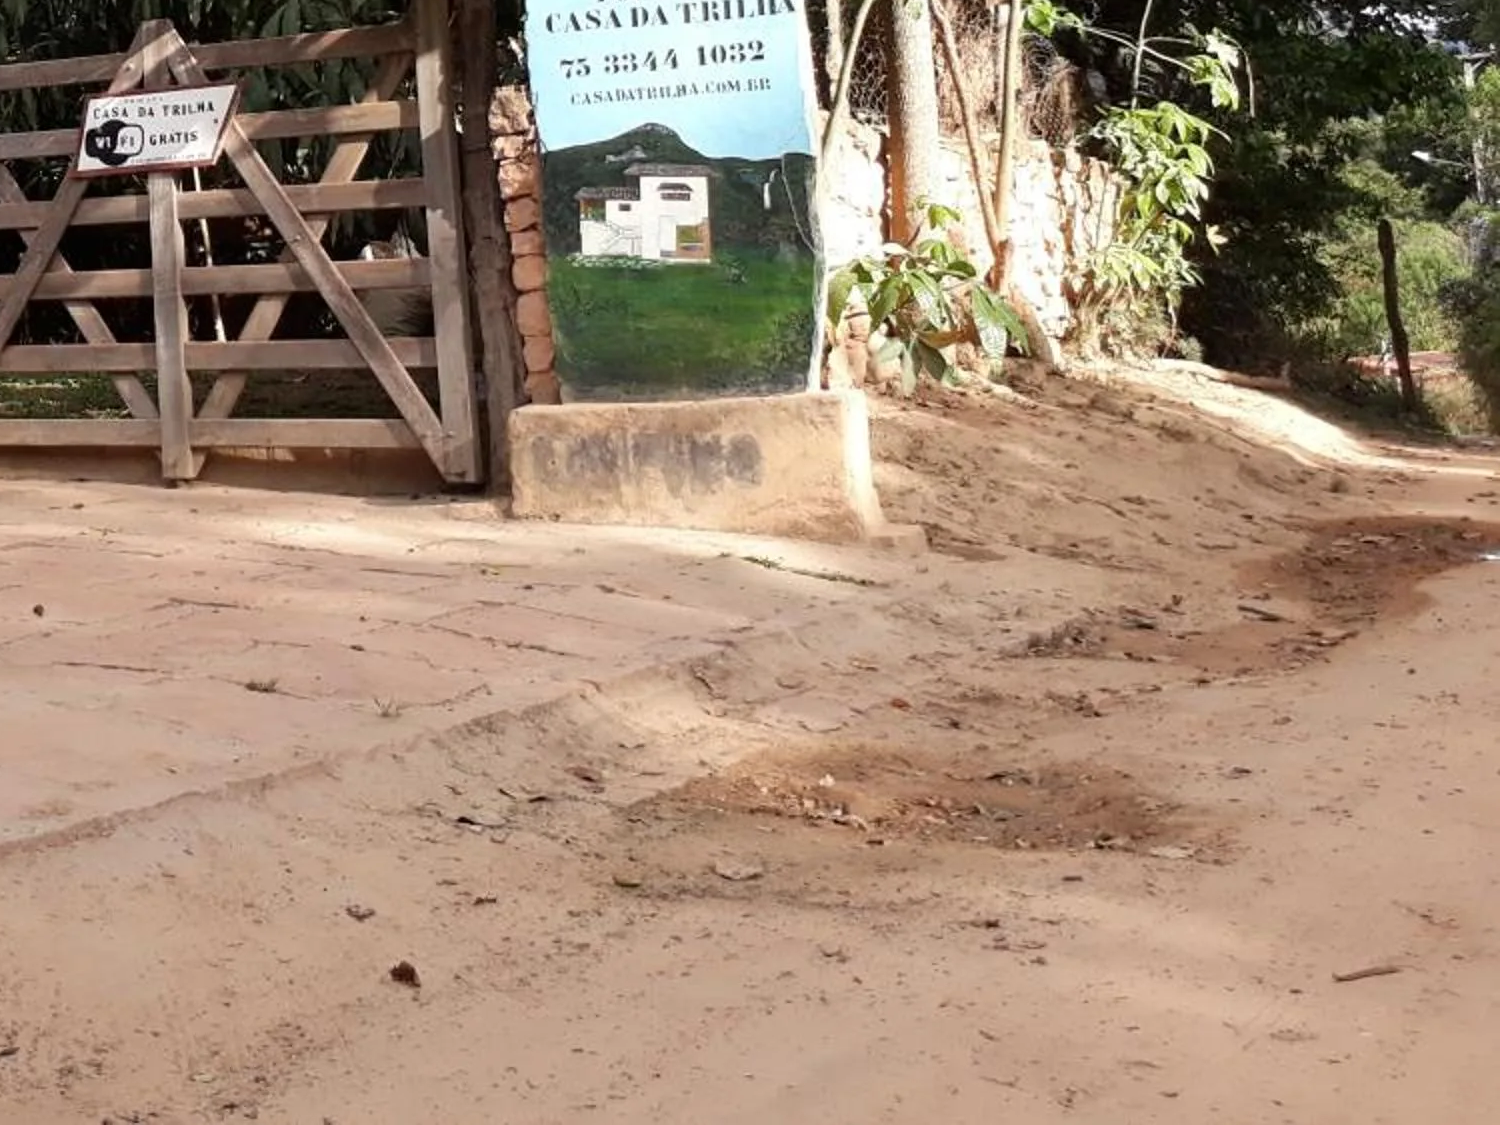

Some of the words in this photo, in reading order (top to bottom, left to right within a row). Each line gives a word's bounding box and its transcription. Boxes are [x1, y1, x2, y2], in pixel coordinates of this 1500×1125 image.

[545, 10, 621, 34] CASA
[631, 5, 668, 27] DA
[559, 57, 591, 79] 75
[603, 48, 680, 74] 3344
[696, 40, 766, 67] 1032
[570, 78, 772, 106] CASADATRILHA.COM.BR
[93, 105, 129, 120] CASA
[137, 106, 155, 118] DA
[162, 101, 215, 117] TRILHA
